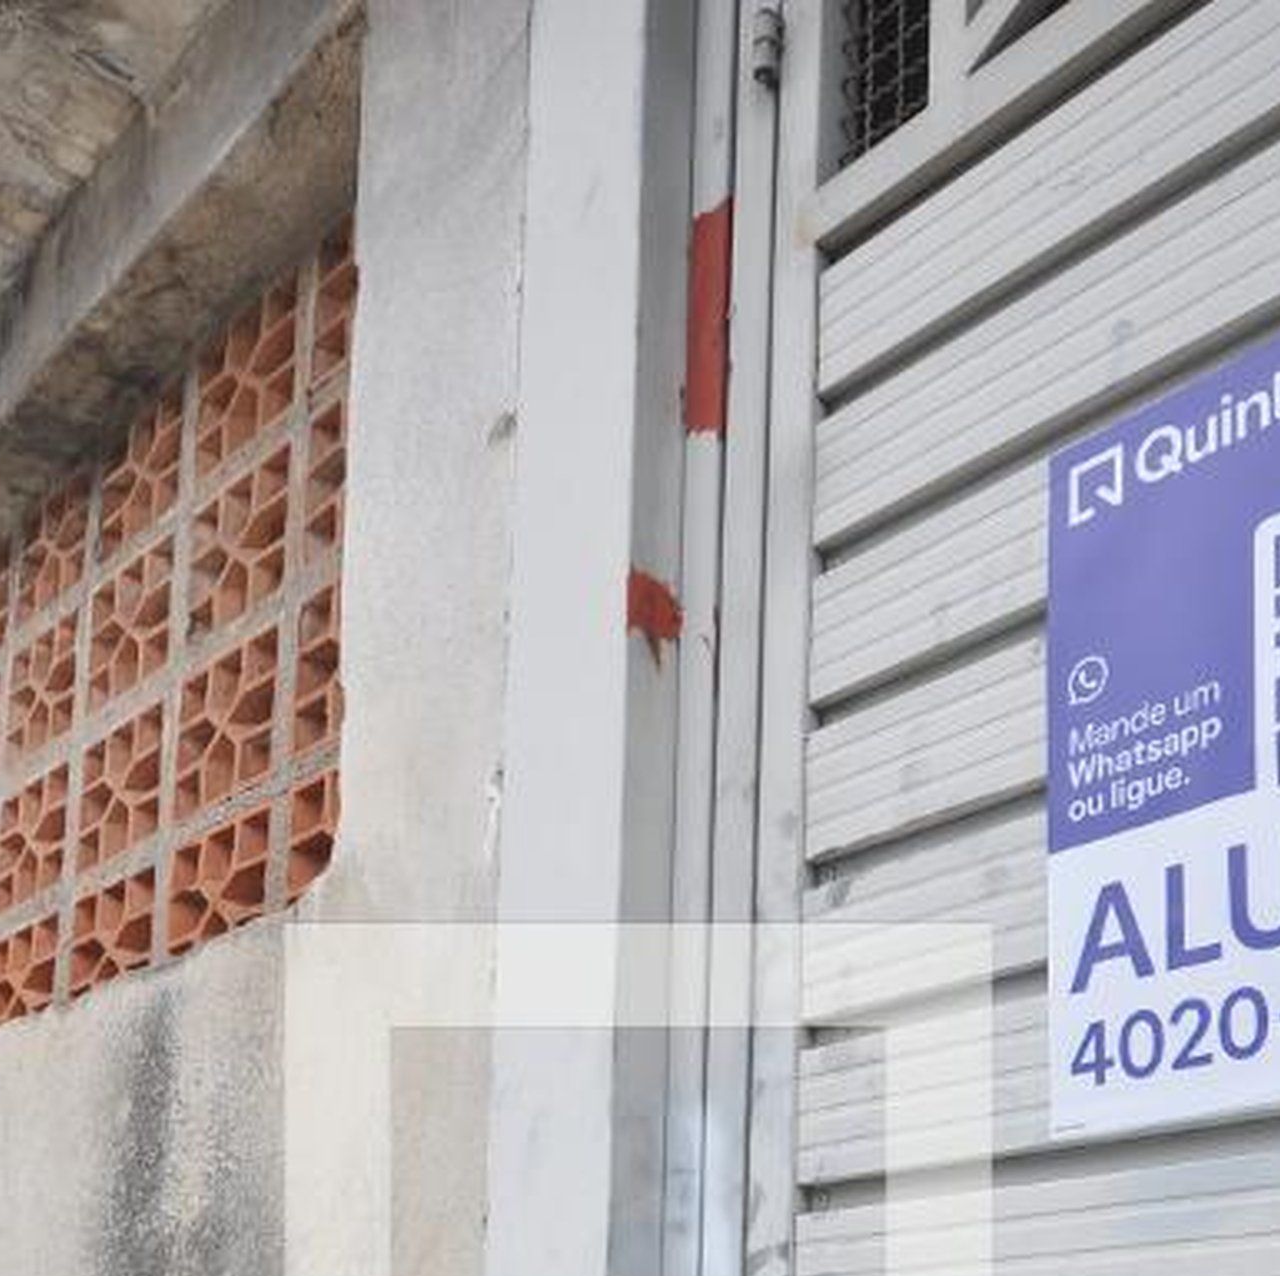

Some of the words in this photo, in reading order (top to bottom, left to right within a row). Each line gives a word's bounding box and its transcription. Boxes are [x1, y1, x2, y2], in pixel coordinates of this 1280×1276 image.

[1067, 715, 1222, 790] Whatsapp
[1069, 701, 1166, 757] Mande
[1174, 681, 1220, 716] um
[1068, 793, 1104, 823] ou
[1110, 766, 1190, 811] ligue.
